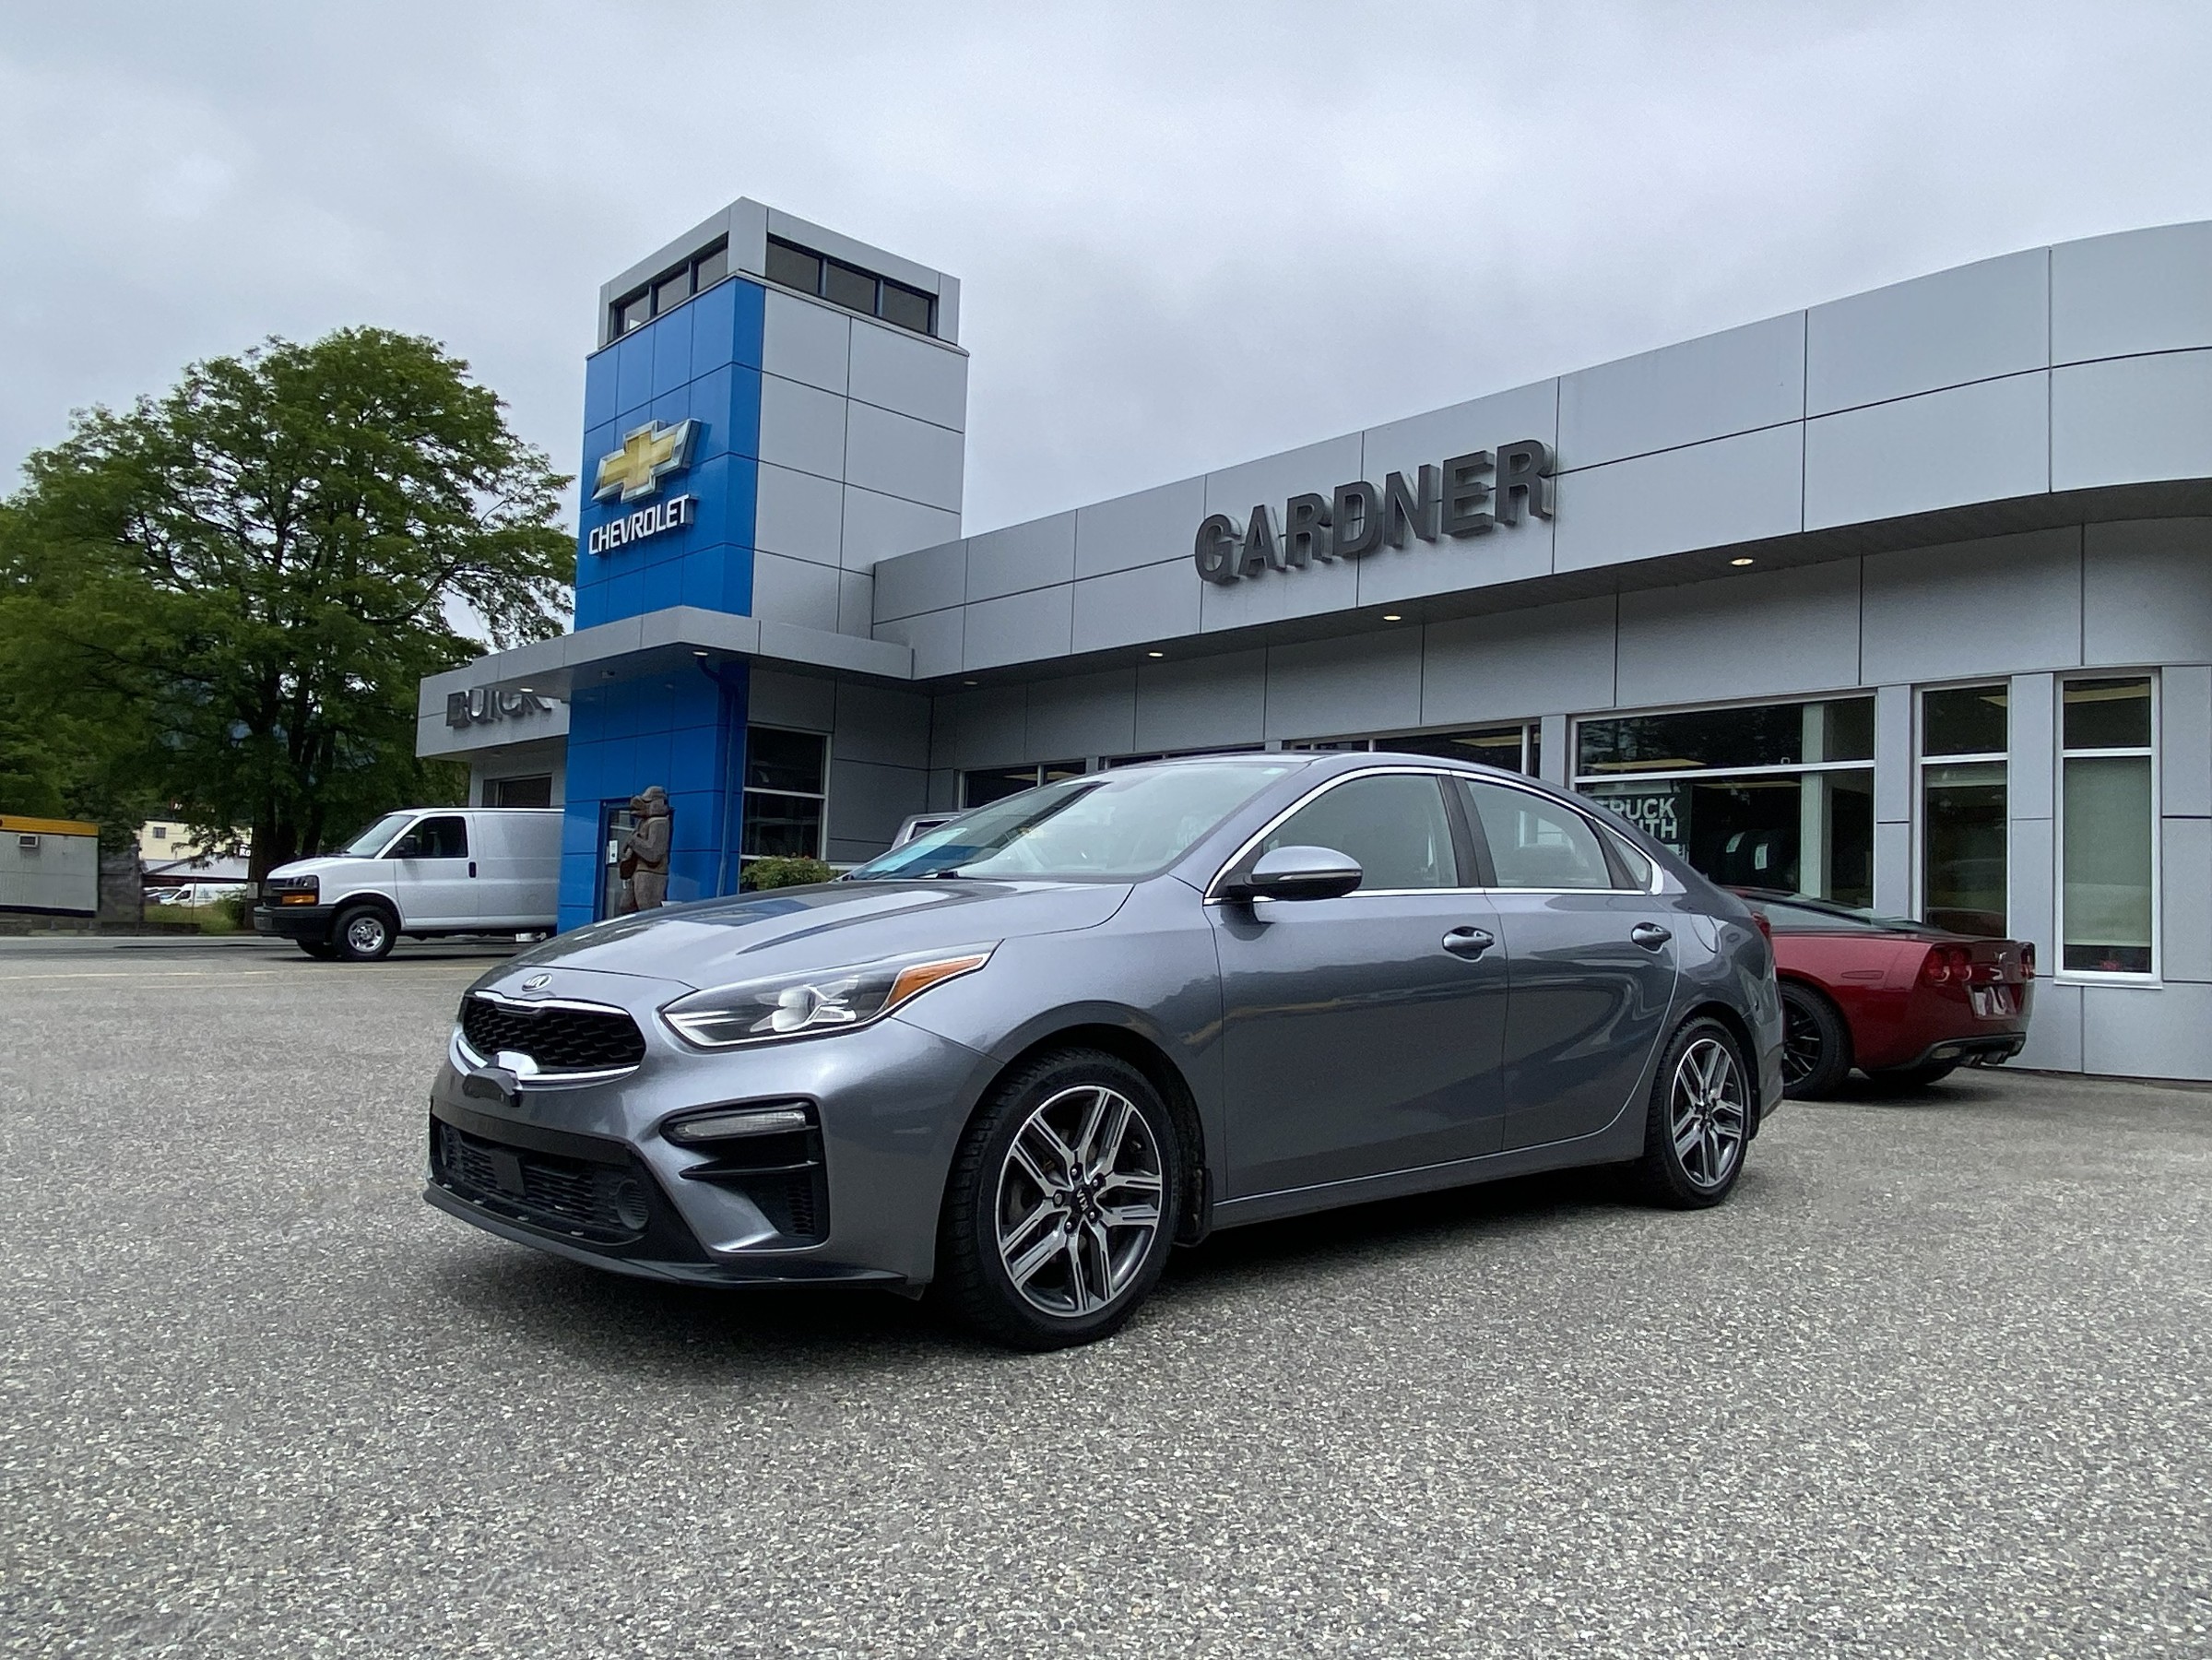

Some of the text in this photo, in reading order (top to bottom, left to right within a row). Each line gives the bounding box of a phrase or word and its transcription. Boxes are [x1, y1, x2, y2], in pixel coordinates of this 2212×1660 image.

[589, 493, 690, 555] CHEVROLET
[1195, 439, 1555, 585] GARDNER
[1076, 1189, 1089, 1212] KIA
